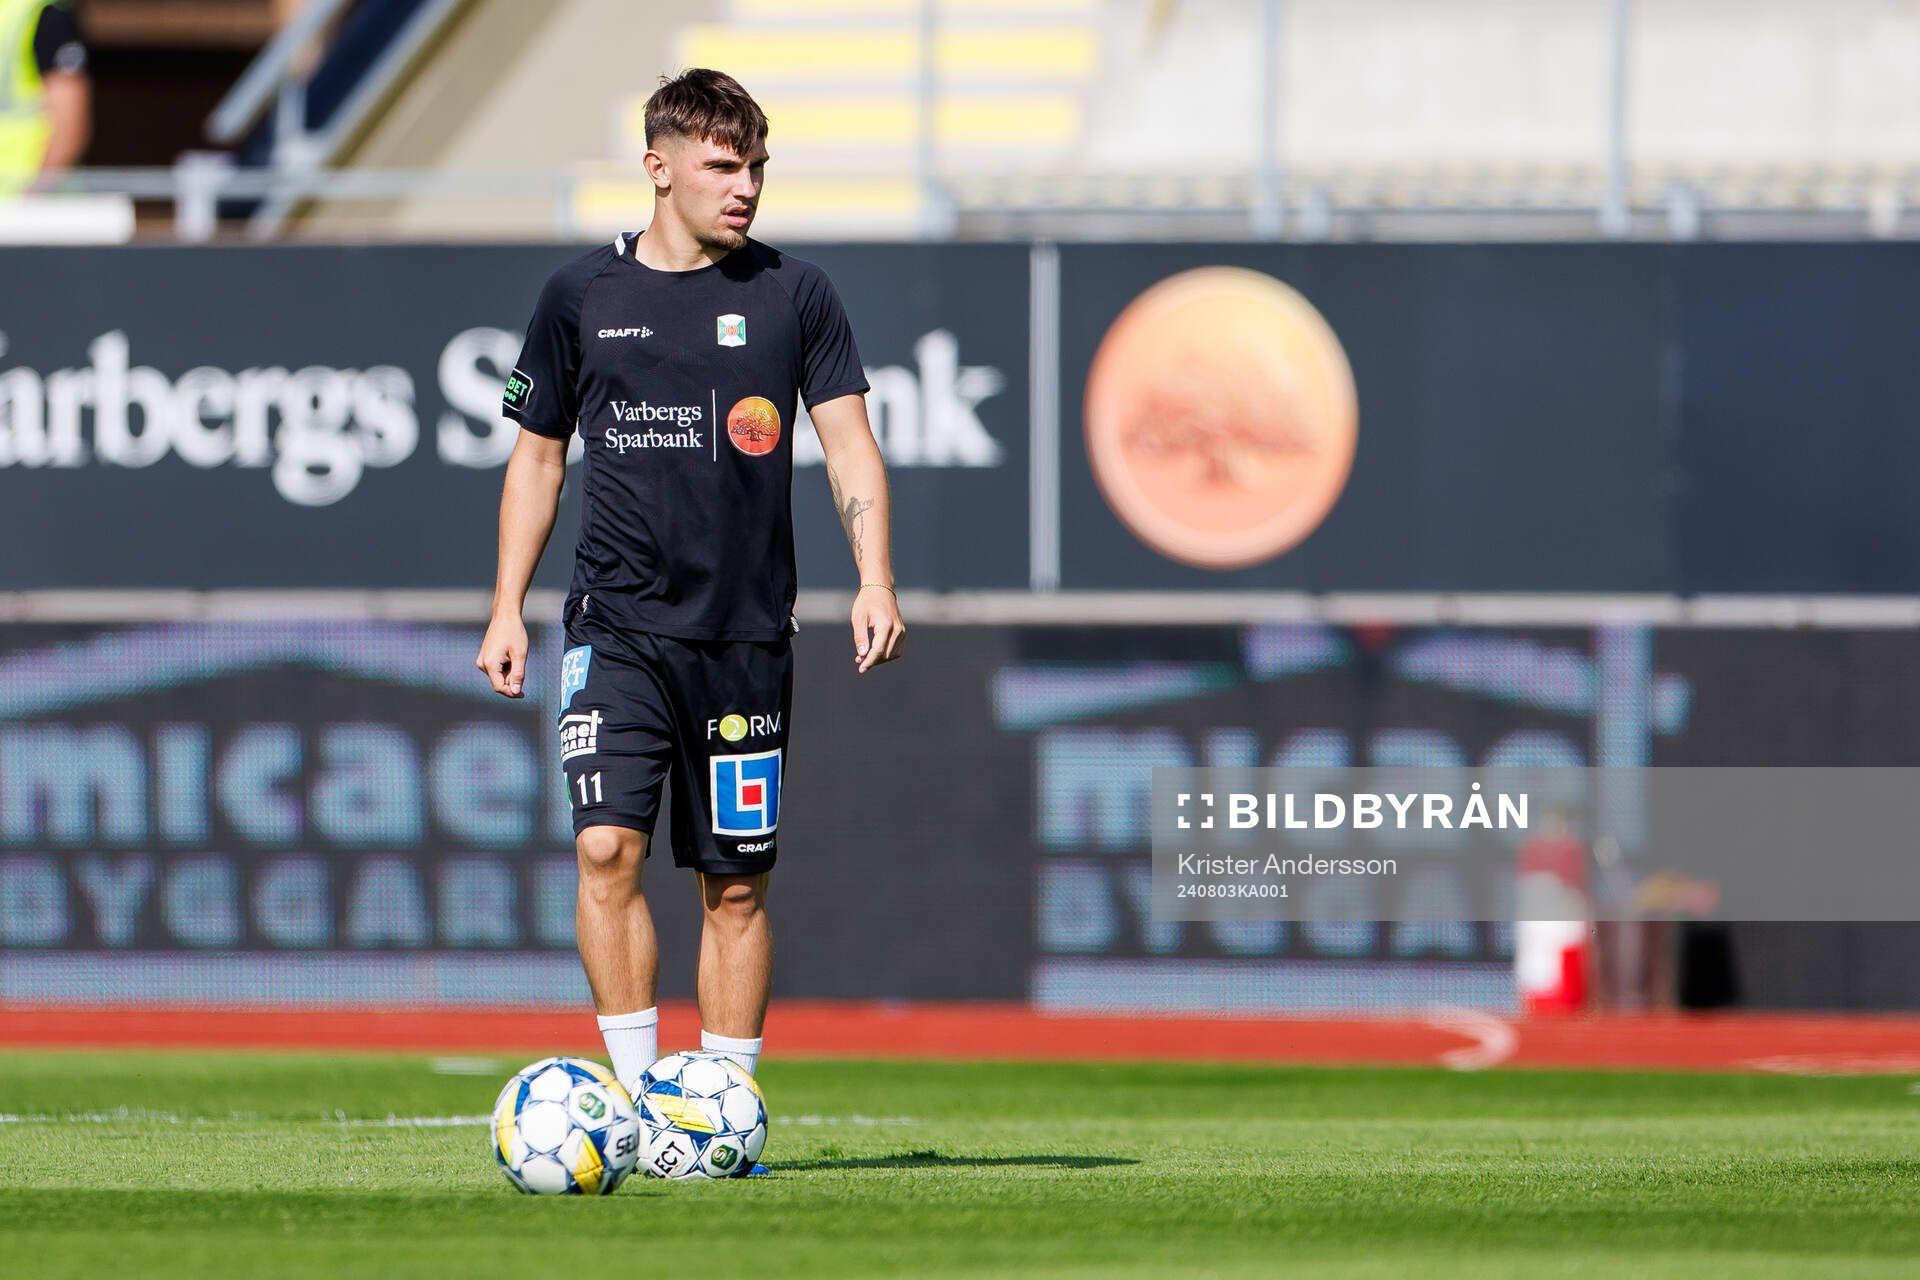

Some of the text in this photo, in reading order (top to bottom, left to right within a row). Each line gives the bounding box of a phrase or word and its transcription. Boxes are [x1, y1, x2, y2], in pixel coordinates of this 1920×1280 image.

[598, 328, 641, 338] CRAFT
[0, 329, 420, 505] arbergs
[609, 401, 703, 427] Varbergs
[605, 427, 704, 454] Sparbank
[577, 771, 603, 805] 11
